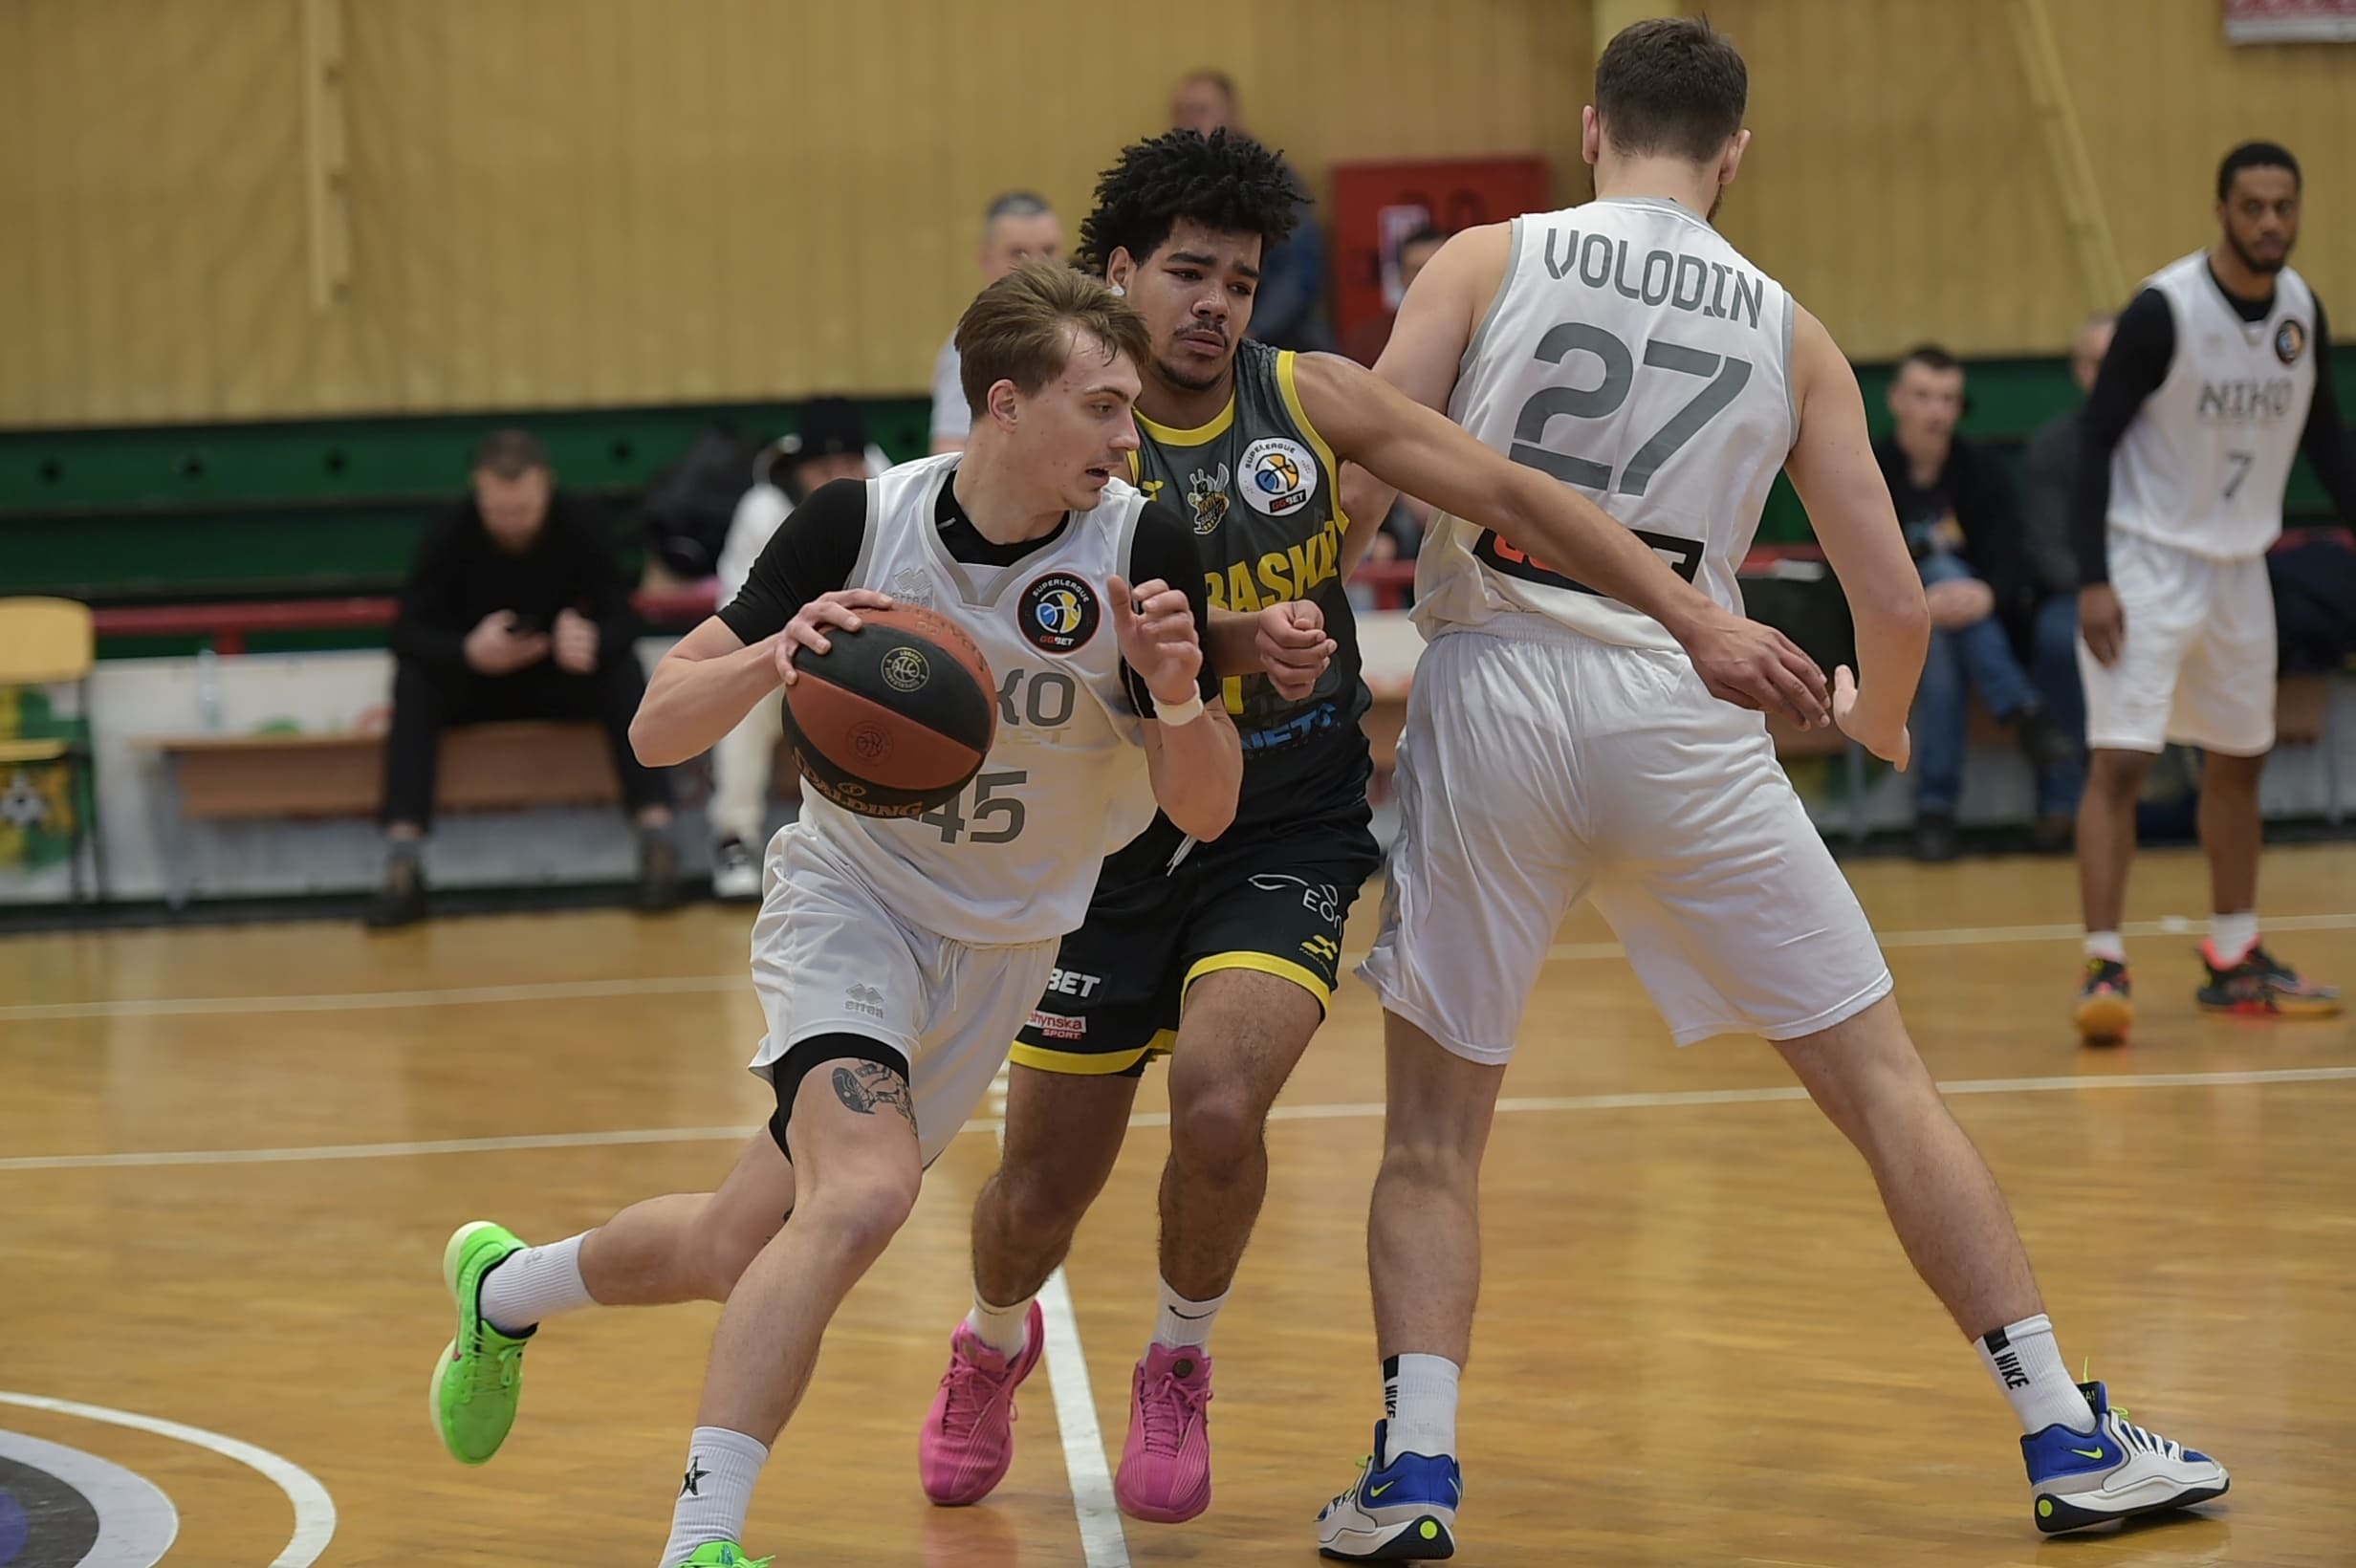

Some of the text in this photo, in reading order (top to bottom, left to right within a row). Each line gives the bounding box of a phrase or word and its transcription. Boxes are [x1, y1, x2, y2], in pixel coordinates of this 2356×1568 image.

[1543, 227, 1765, 329] VOLODIN
[1509, 322, 1753, 496] 27
[2225, 450, 2254, 499] 7
[1033, 578, 1090, 603] SUPERLEAGUE
[910, 771, 1037, 844] 45
[1048, 968, 1102, 998] BET
[1041, 1028, 1081, 1040] SPORT
[1993, 1351, 2030, 1390] NIKE
